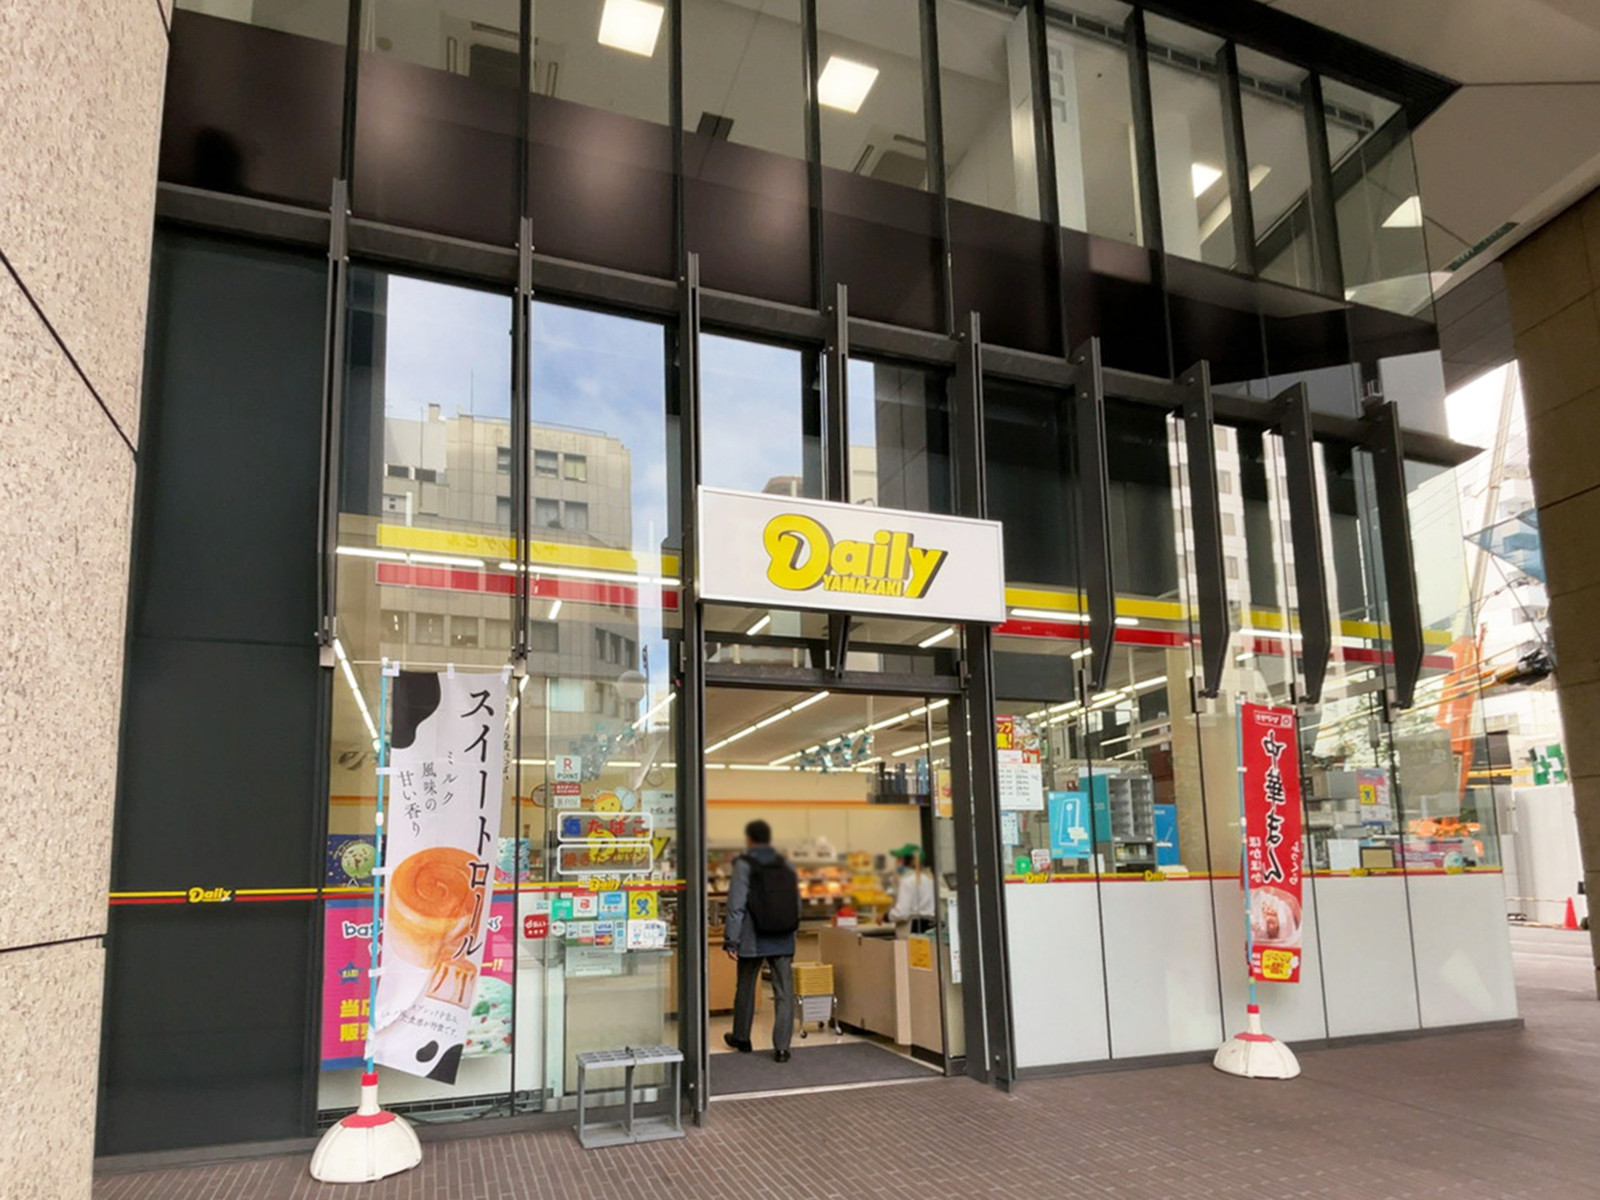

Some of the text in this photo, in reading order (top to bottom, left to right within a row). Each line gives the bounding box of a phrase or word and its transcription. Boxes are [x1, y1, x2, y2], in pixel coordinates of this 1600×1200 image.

[762, 513, 948, 598] Daily
[823, 575, 906, 598] YAMAZAKI
[442, 751, 458, 806] ミルク
[557, 772, 579, 780] POINT
[563, 758, 572, 770] R
[397, 770, 421, 838] 甘い香り
[422, 761, 438, 812] 風味の
[453, 690, 494, 960] スイートロール
[588, 819, 647, 836] たばこ
[189, 887, 233, 903] Daily
